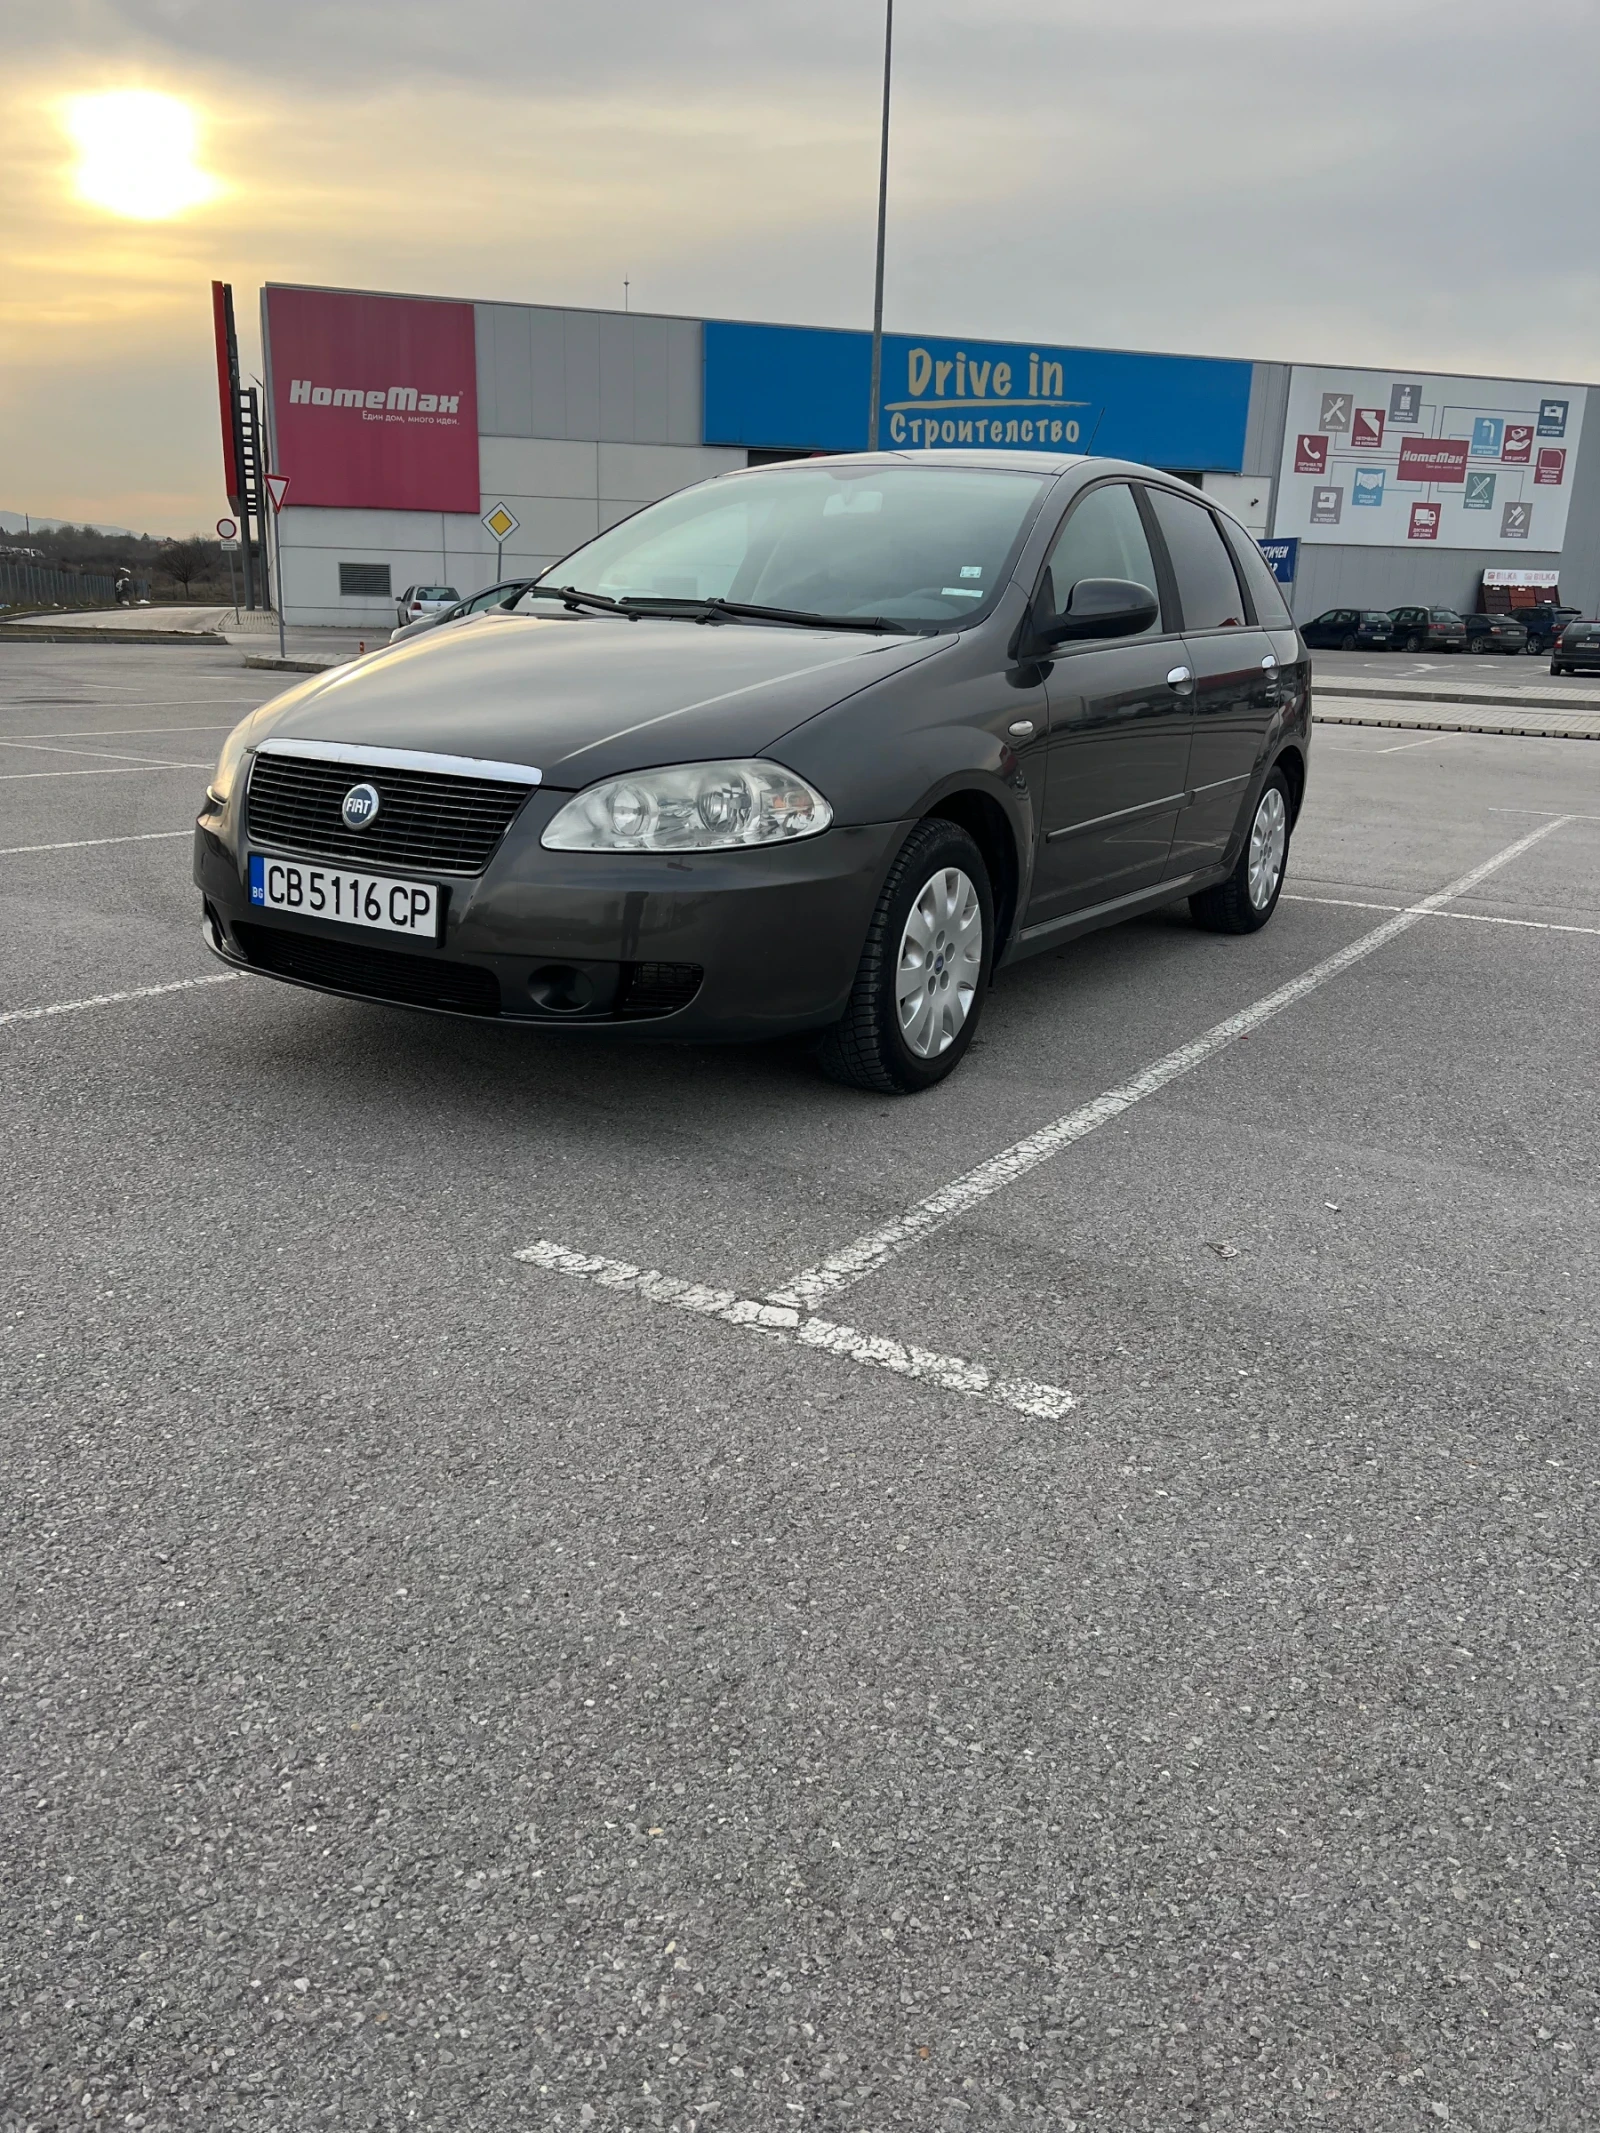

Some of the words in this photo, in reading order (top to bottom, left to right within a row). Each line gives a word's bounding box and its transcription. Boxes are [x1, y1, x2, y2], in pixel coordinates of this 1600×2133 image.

[908, 347, 1012, 398] Drive
[1028, 352, 1063, 397] in
[289, 379, 460, 414] HomeMax
[362, 410, 383, 421] Един
[385, 413, 405, 424] дом,
[408, 416, 435, 424] много
[436, 417, 460, 425] идеи.
[890, 412, 1080, 449] Строителство
[1401, 450, 1464, 464] HomeMax
[345, 797, 371, 815] FIAT
[252, 886, 264, 899] BG
